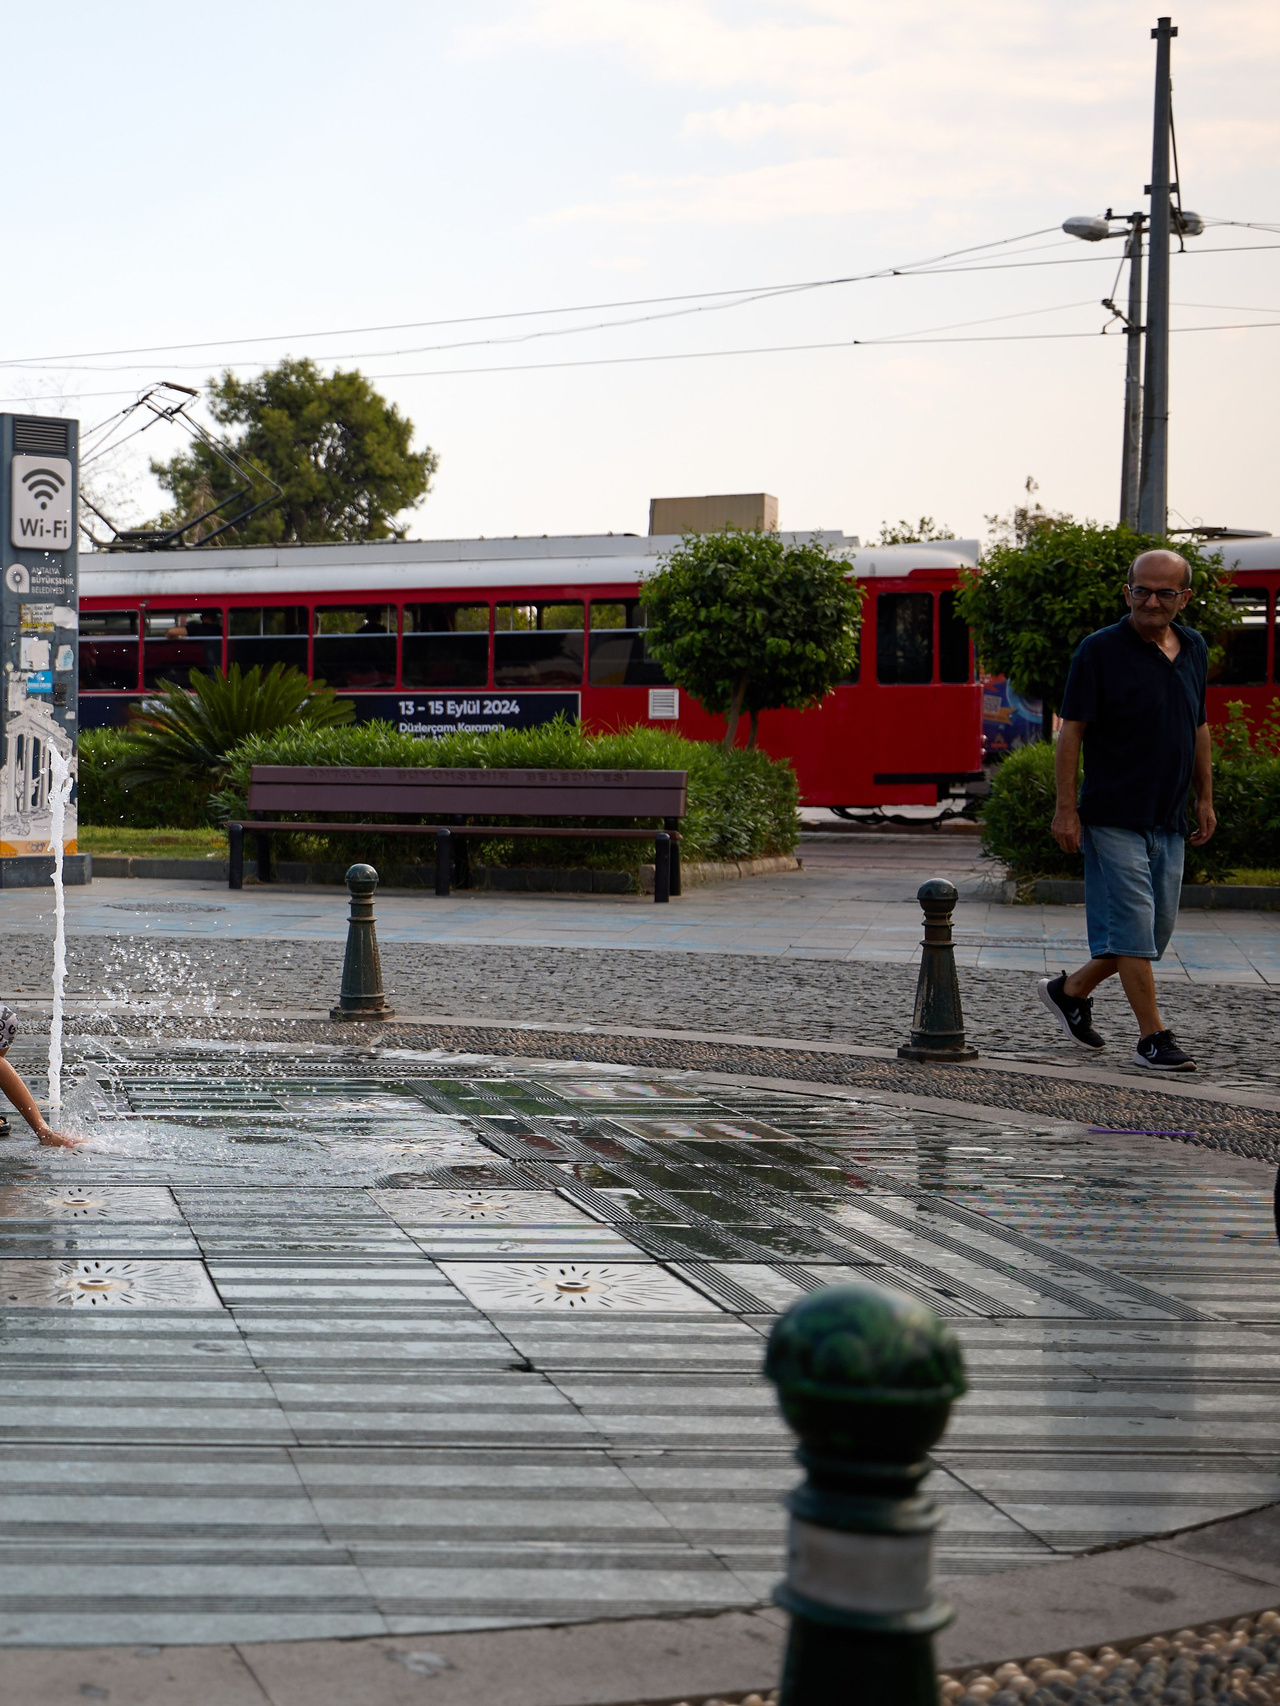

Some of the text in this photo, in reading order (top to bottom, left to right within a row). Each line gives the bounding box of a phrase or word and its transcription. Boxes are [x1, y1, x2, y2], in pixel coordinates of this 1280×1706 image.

[20, 518, 68, 539] Wi-Fi
[31, 566, 60, 575] ANTALYA
[31, 574, 74, 586] BÜYÜKŞEHİR
[31, 585, 65, 595] BELEDİYESİ
[398, 700, 415, 716] 13
[428, 700, 444, 715] 15
[446, 700, 480, 718] Eylül
[483, 699, 521, 715] 2024
[399, 722, 505, 735] Düzlerçamı Karaman
